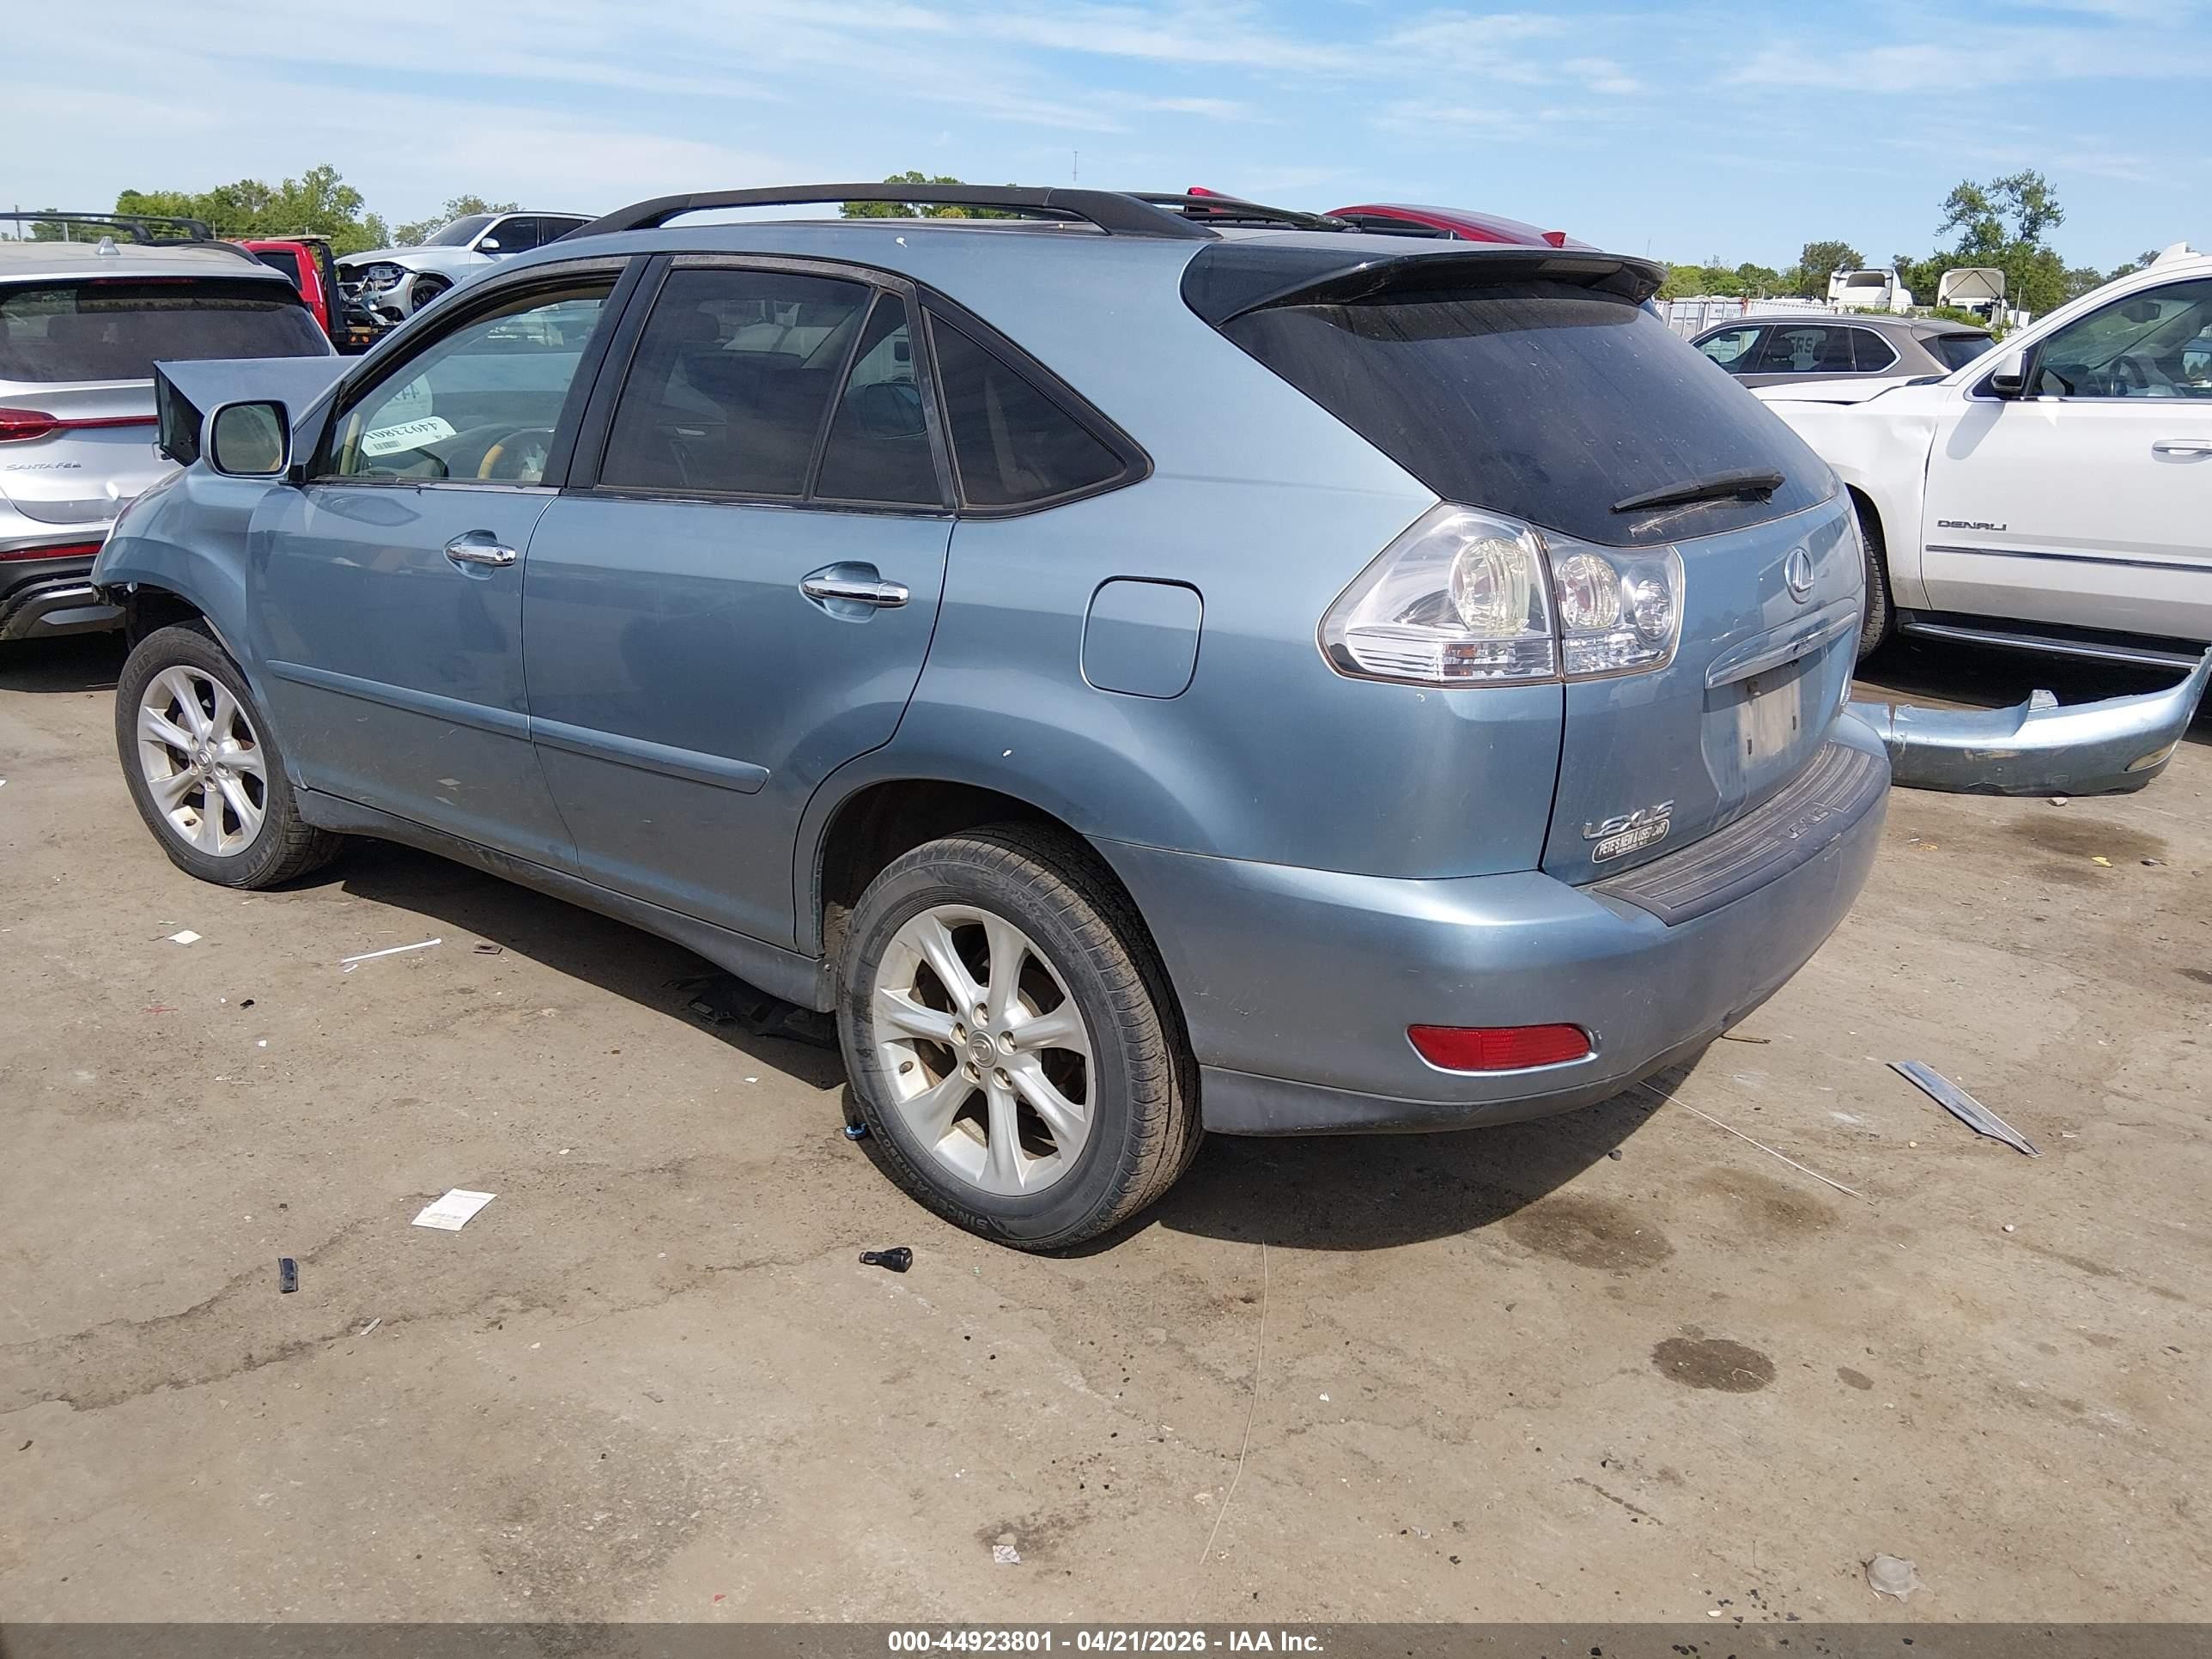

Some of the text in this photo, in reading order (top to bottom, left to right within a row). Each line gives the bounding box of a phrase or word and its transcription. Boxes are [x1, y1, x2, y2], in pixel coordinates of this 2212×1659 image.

[5, 463, 53, 471] SANTA
[1937, 520, 2007, 532] DENALI
[1583, 799, 1674, 839] LEXUS
[1599, 838, 1621, 855] PETE'S
[1620, 832, 1635, 848] NEW
[916, 1182, 988, 1231] SINCERA
